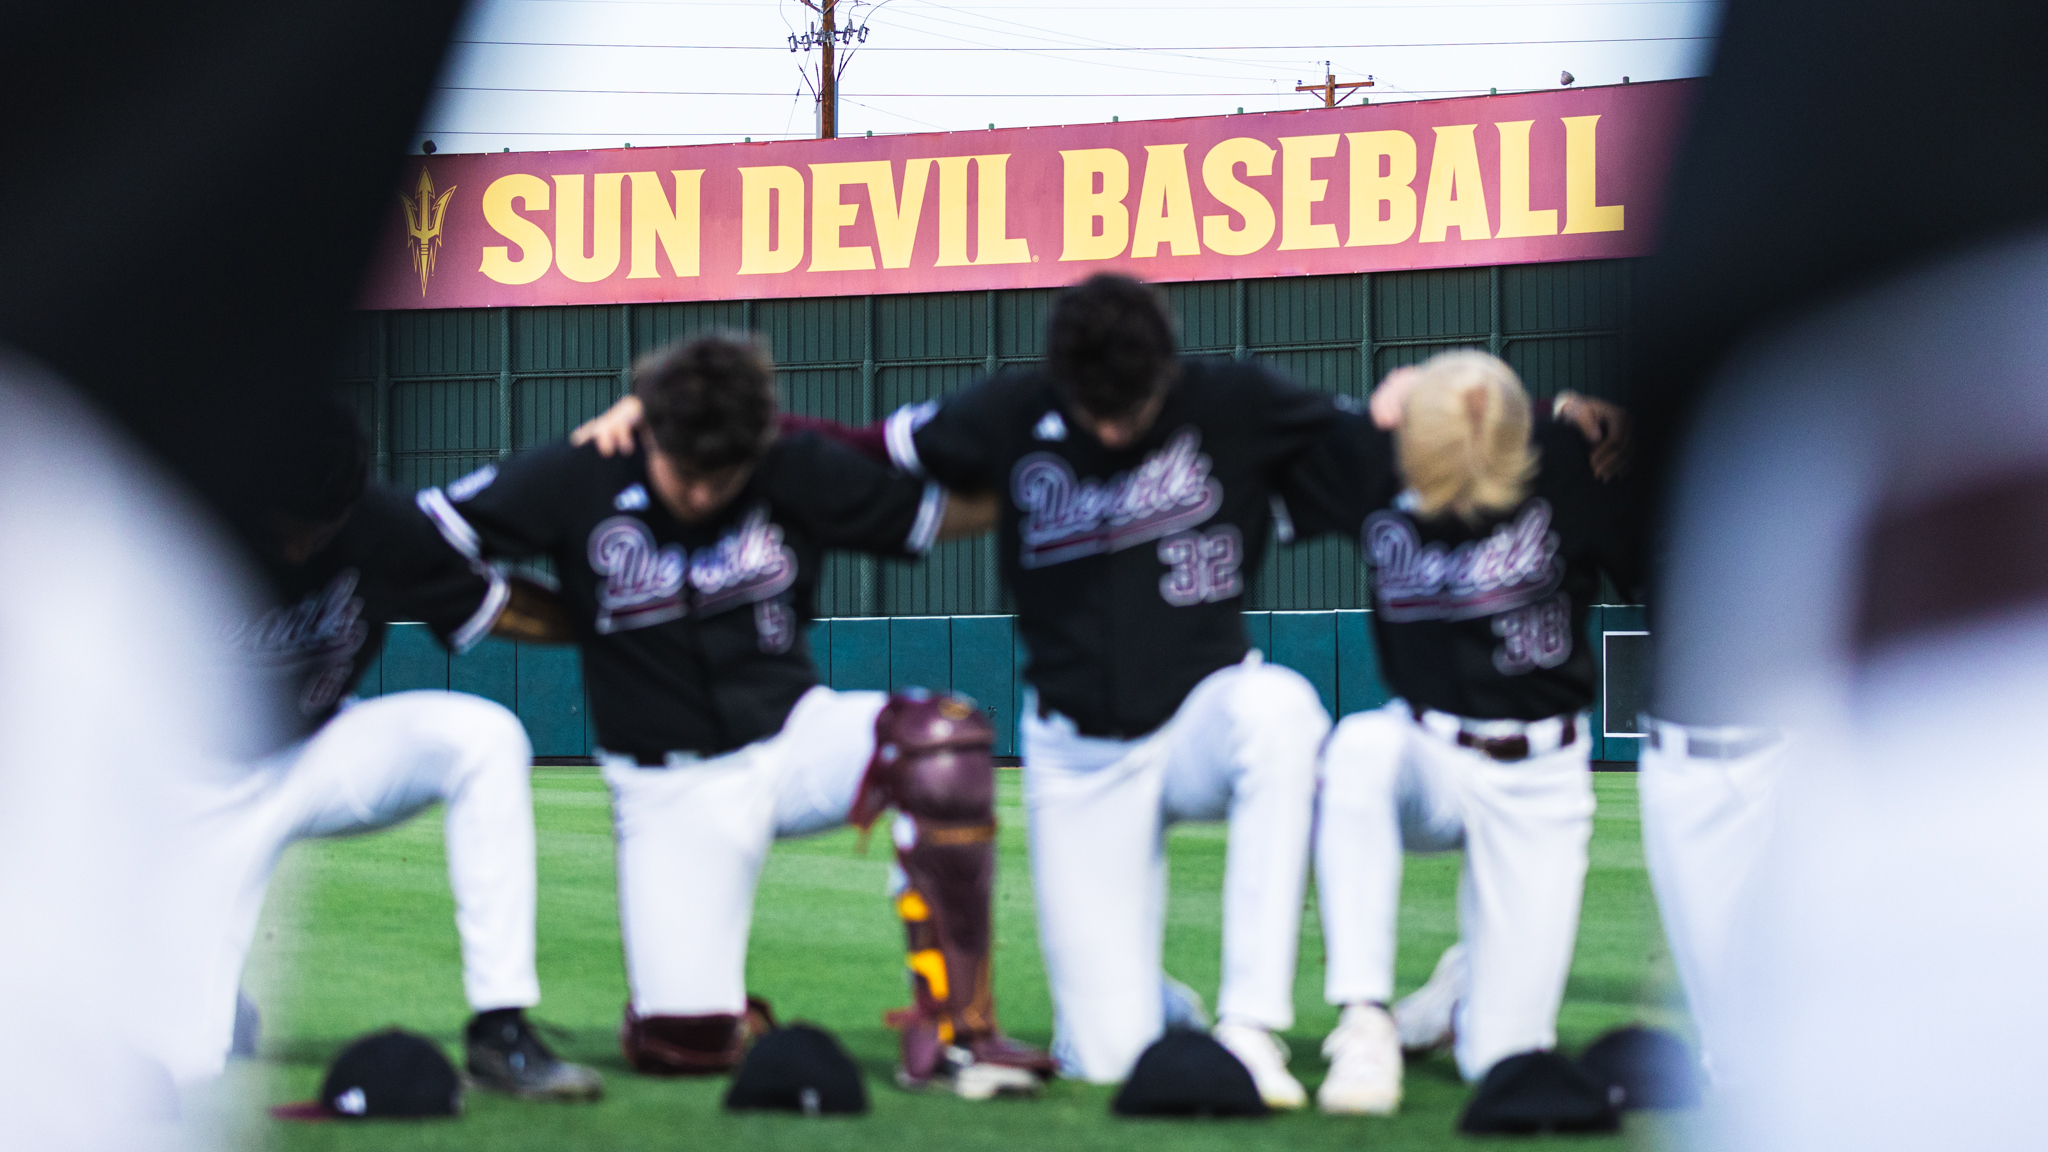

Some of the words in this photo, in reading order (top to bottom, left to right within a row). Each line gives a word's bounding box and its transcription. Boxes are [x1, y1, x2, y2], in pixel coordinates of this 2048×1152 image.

[478, 168, 706, 286] SUN
[1058, 114, 1625, 262] BASEBALL
[1158, 524, 1243, 606] 32
